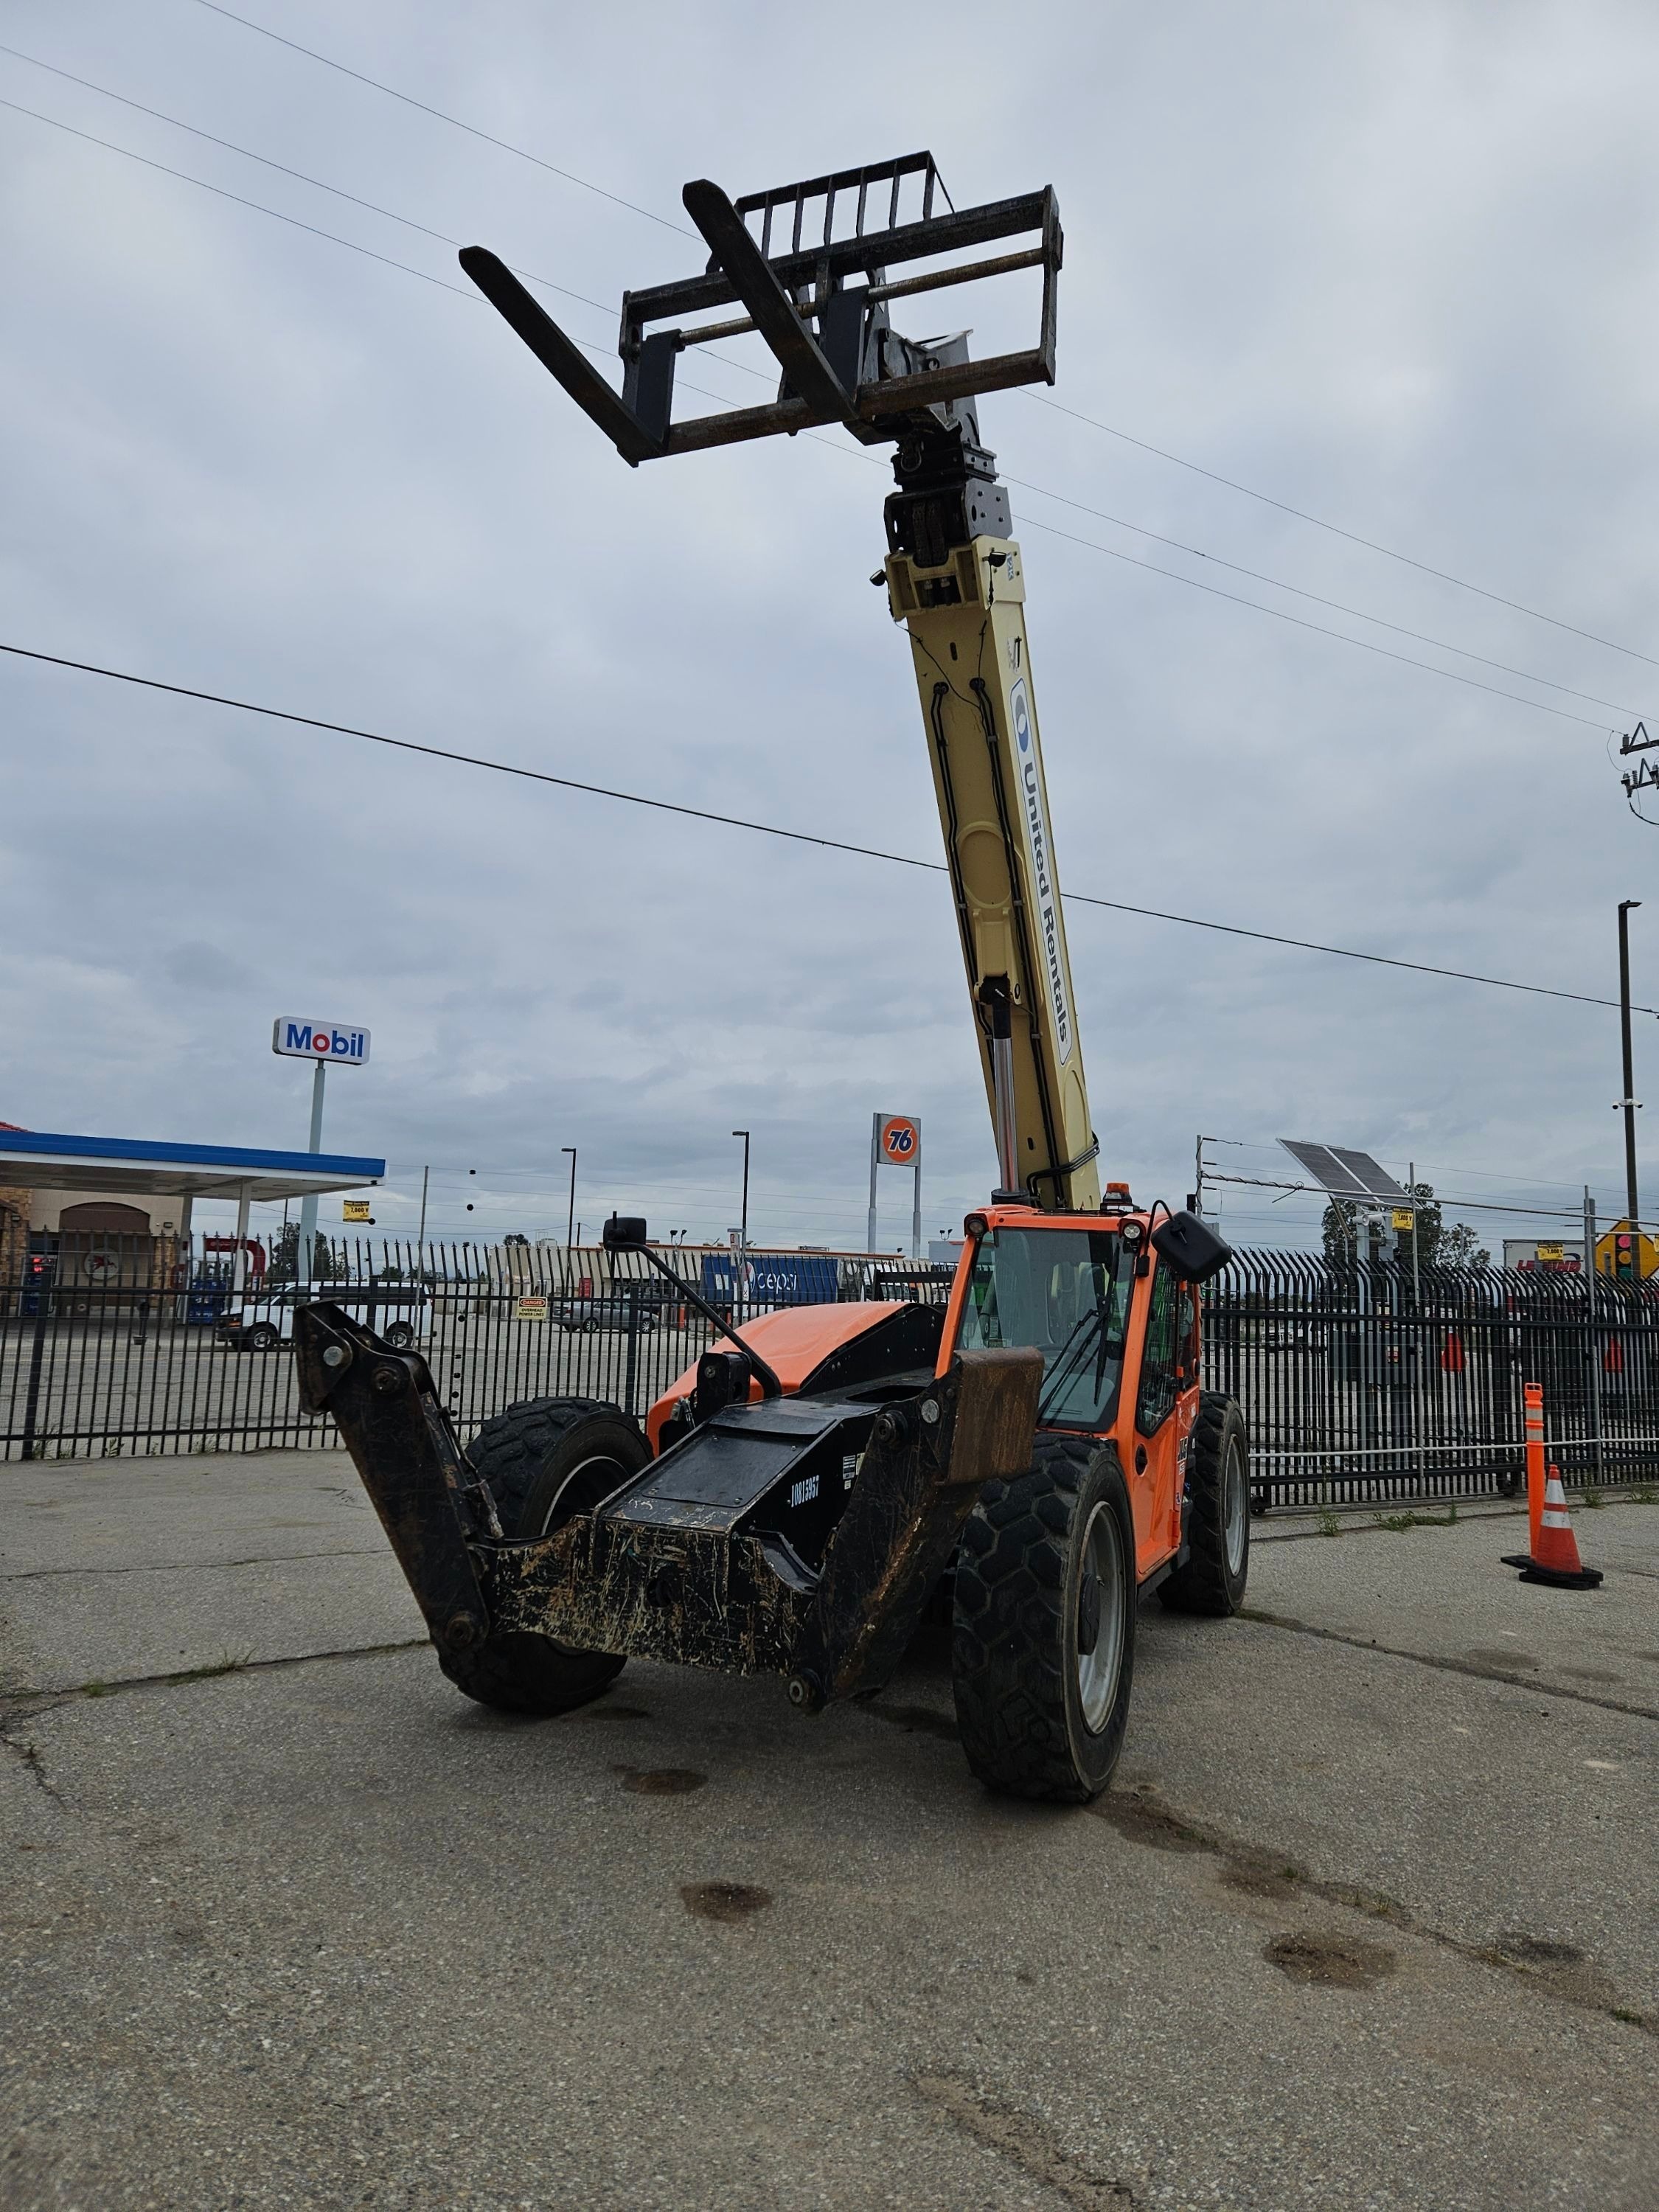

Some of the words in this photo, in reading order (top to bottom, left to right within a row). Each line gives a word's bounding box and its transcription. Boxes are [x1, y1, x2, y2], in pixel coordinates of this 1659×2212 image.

[1025, 762, 1049, 897] United
[1043, 906, 1067, 1043] Rentals
[286, 1023, 364, 1057] Mobil
[887, 1127, 914, 1153] 76
